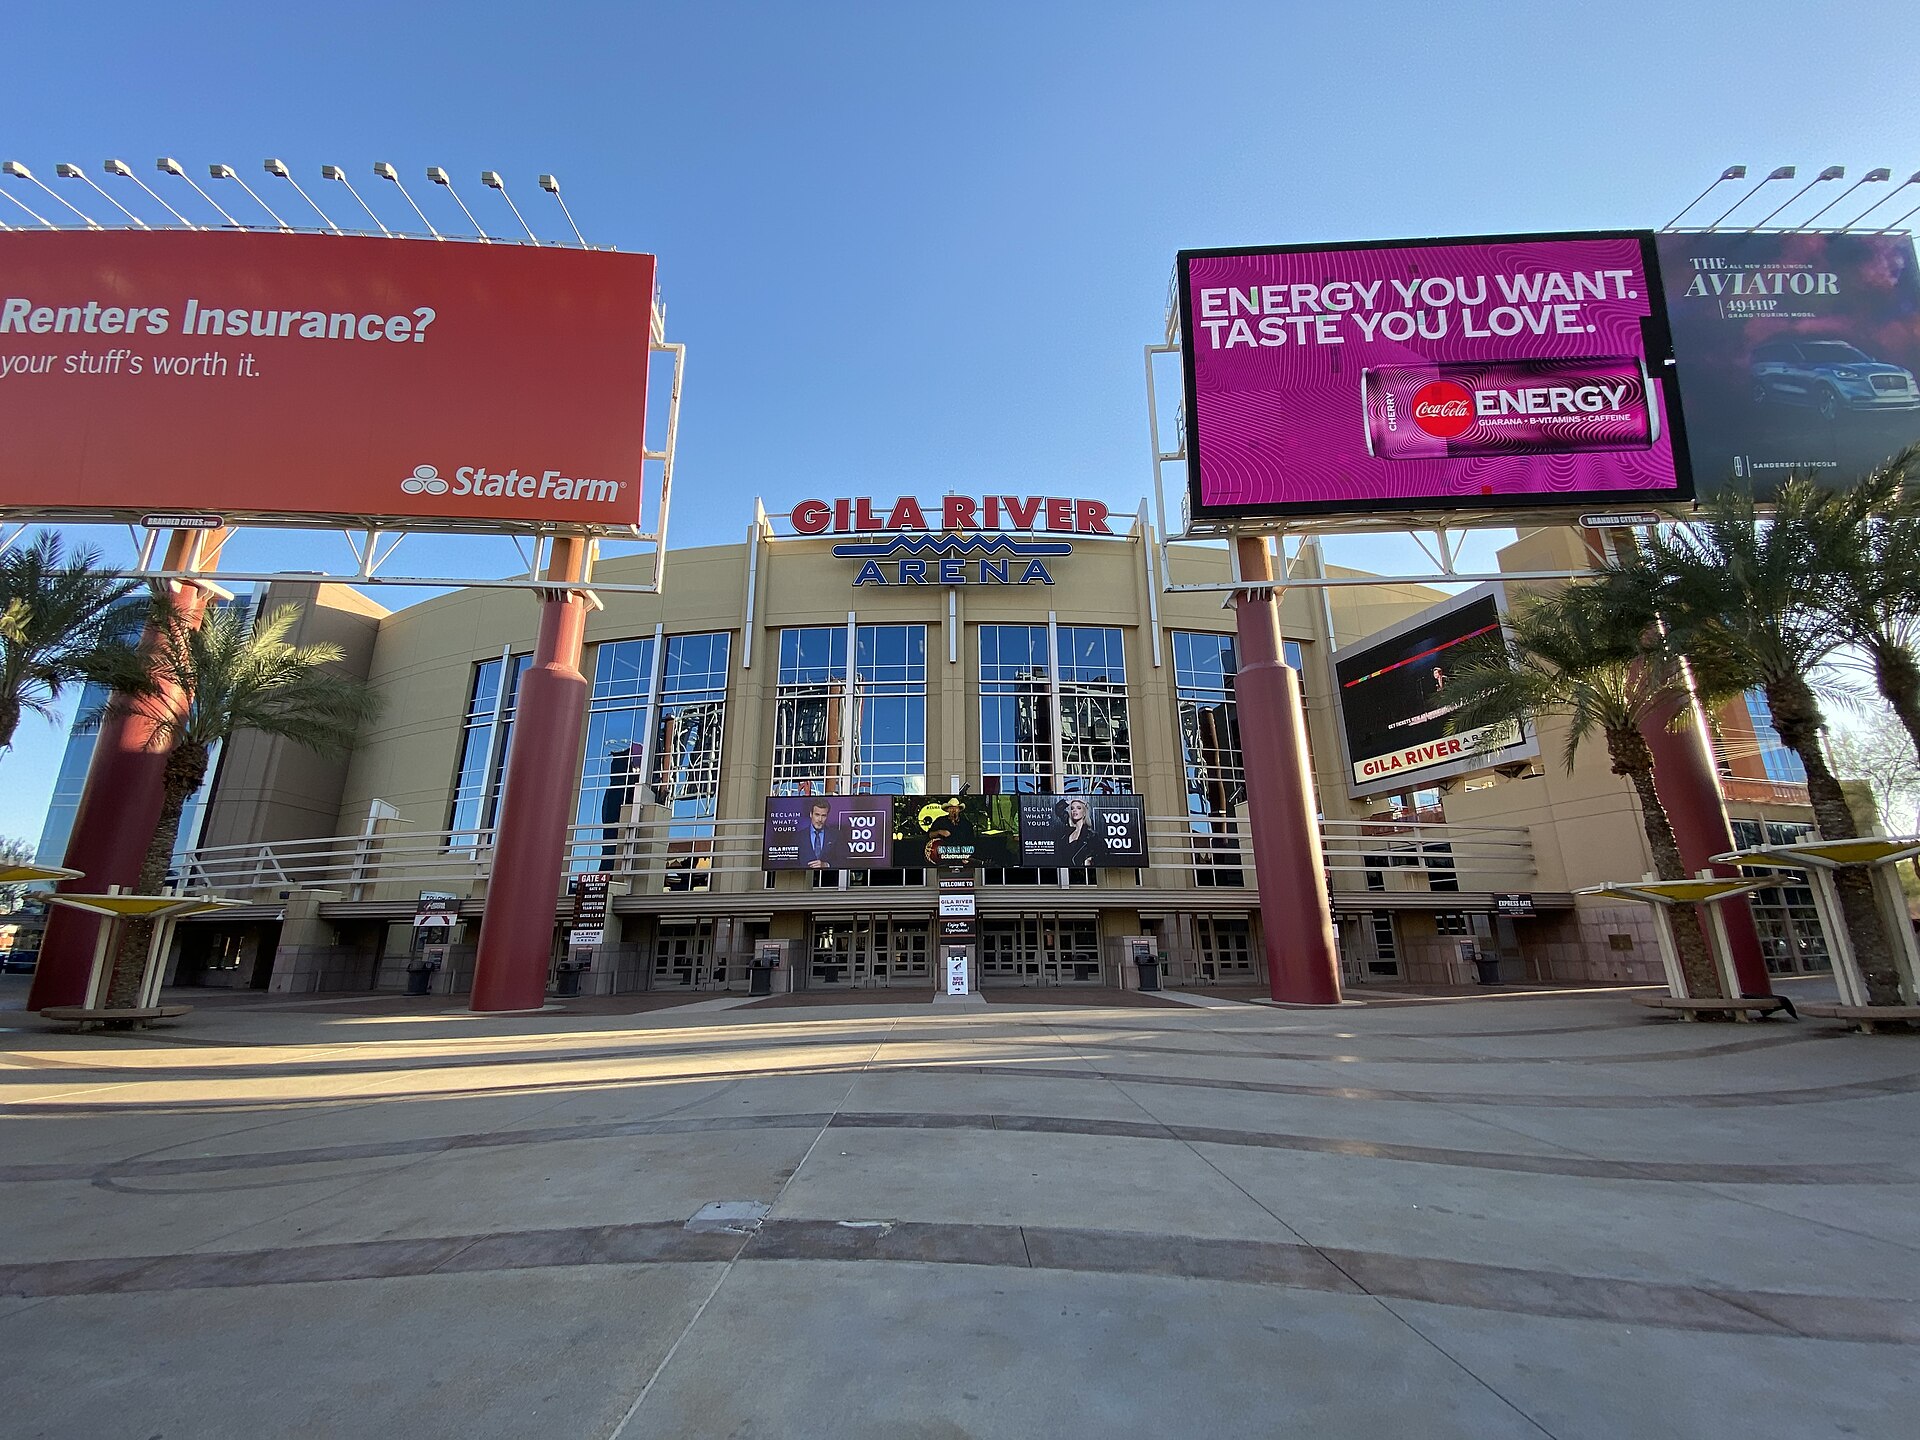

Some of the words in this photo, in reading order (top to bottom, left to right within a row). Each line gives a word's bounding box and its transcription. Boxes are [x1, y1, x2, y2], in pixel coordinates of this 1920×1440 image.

[1690, 257, 1728, 270] THE
[1200, 280, 1383, 317] ENERGY
[1390, 276, 1487, 307] YOU
[1495, 270, 1638, 303] WANT.
[1684, 272, 1840, 297] AVIATOR
[1726, 300, 1778, 312] 494HP
[0, 298, 170, 335] Renters
[182, 299, 436, 343] Insurance?
[1200, 314, 1344, 350] TASTE
[1351, 310, 1448, 342] YOU
[1462, 303, 1596, 338] LOVE.
[0, 355, 57, 378] your
[64, 350, 143, 374] stuff's
[153, 352, 227, 376] worth
[238, 353, 260, 377] it.
[1475, 385, 1627, 415] ENERGY
[1387, 392, 1397, 431] CHERRY
[1478, 418, 1523, 426] GUARANA
[1530, 416, 1581, 425] B-VITAMINS
[1588, 414, 1631, 422] CAFFEINE
[147, 517, 180, 525] BRANDED
[790, 496, 929, 535] GILA
[942, 495, 1114, 534] RIVER
[853, 558, 1055, 586] ARENA
[1363, 755, 1403, 775] GILA
[1405, 738, 1463, 765] RIVER
[848, 816, 875, 827] YOU
[1103, 813, 1130, 823] YOU
[852, 829, 872, 839] DO
[1108, 825, 1127, 836] DO
[848, 842, 875, 852] YOU
[1104, 838, 1132, 848] YOU
